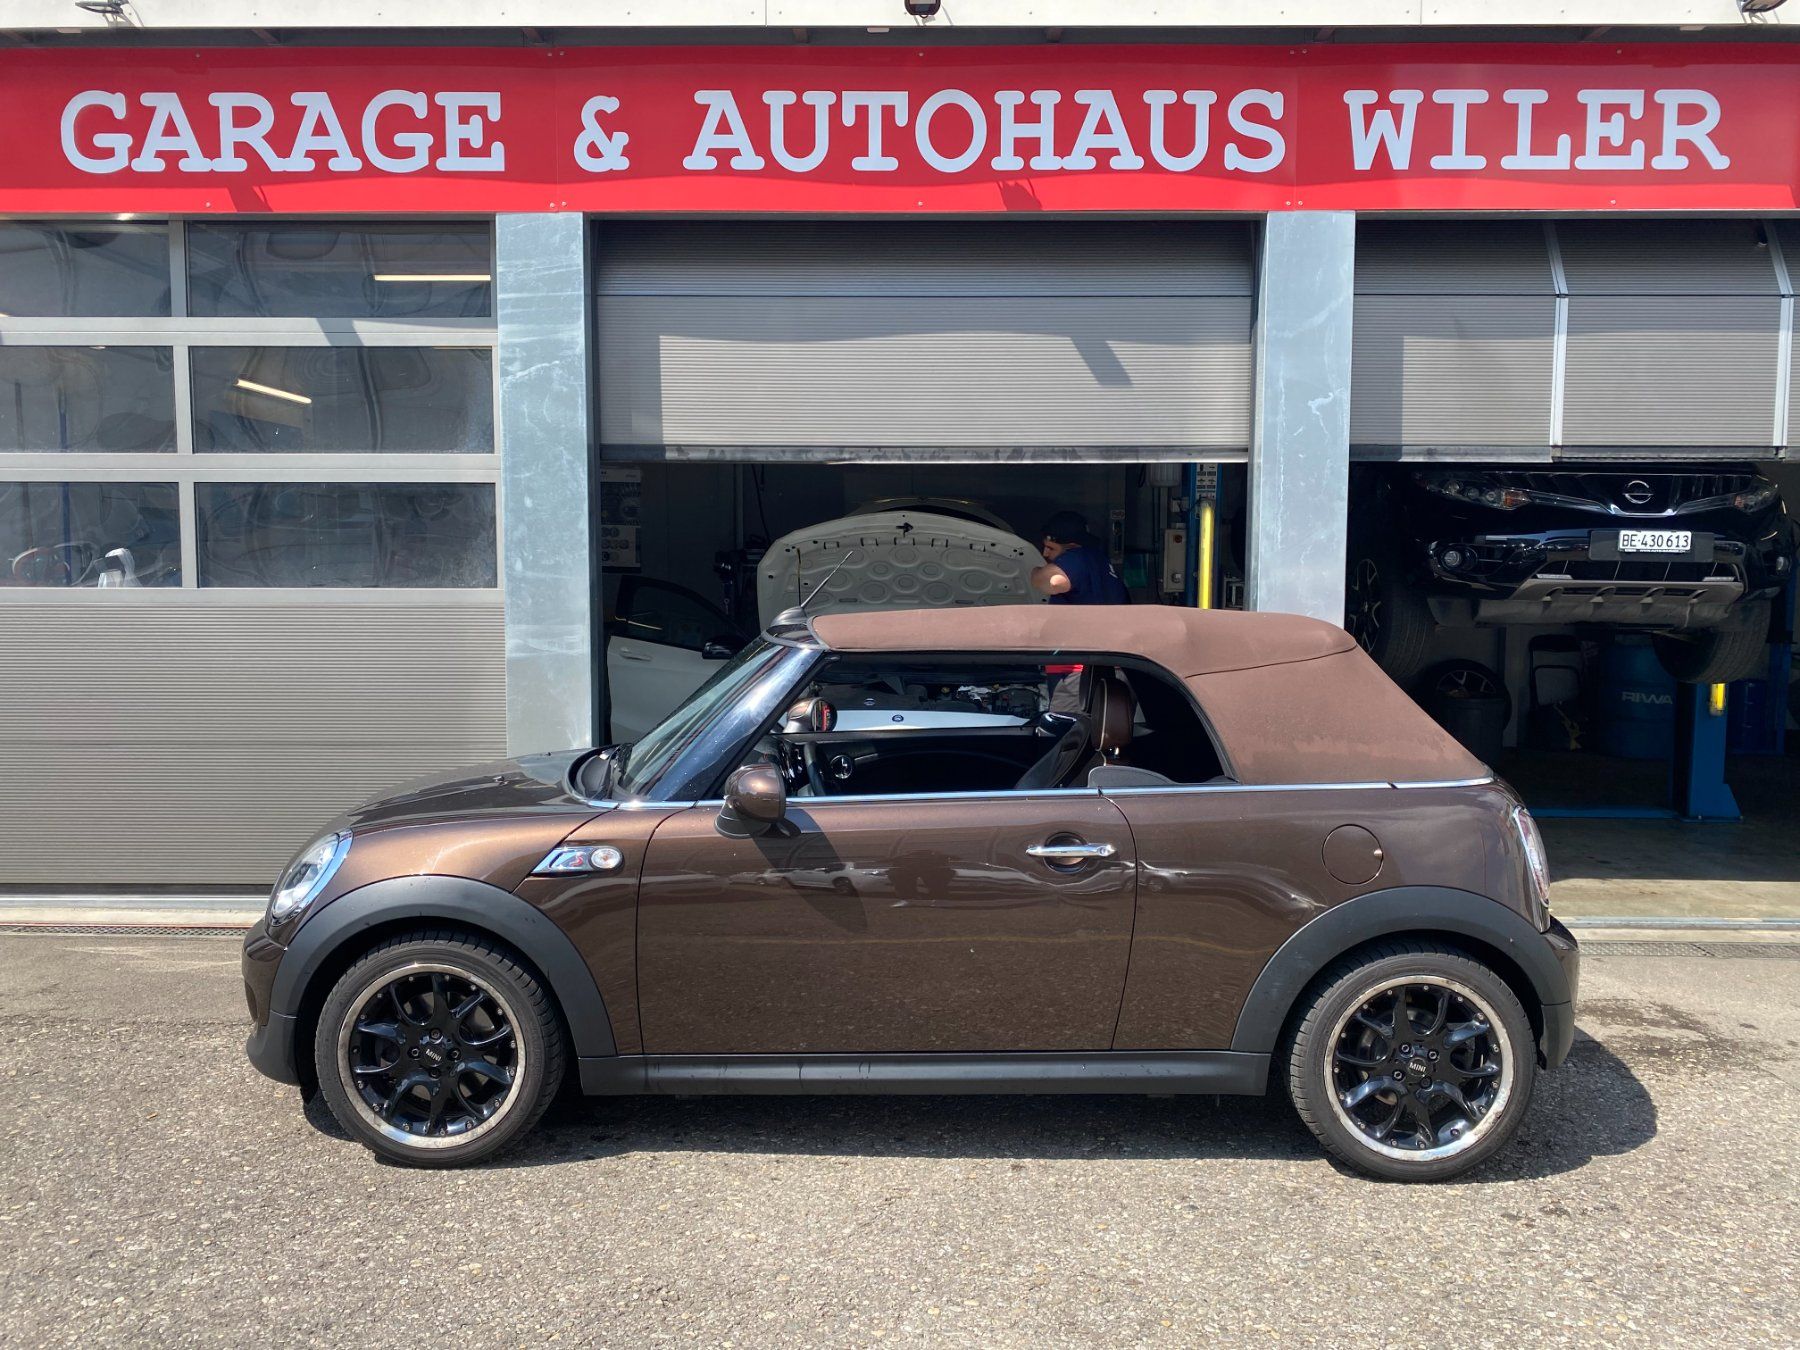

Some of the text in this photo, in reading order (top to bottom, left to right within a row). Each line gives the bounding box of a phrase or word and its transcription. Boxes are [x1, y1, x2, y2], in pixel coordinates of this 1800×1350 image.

[60, 88, 1731, 174] GARAGE & AUTOHAUS WILER
[425, 1048, 442, 1062] MINI
[1409, 1062, 1427, 1073] MINI
